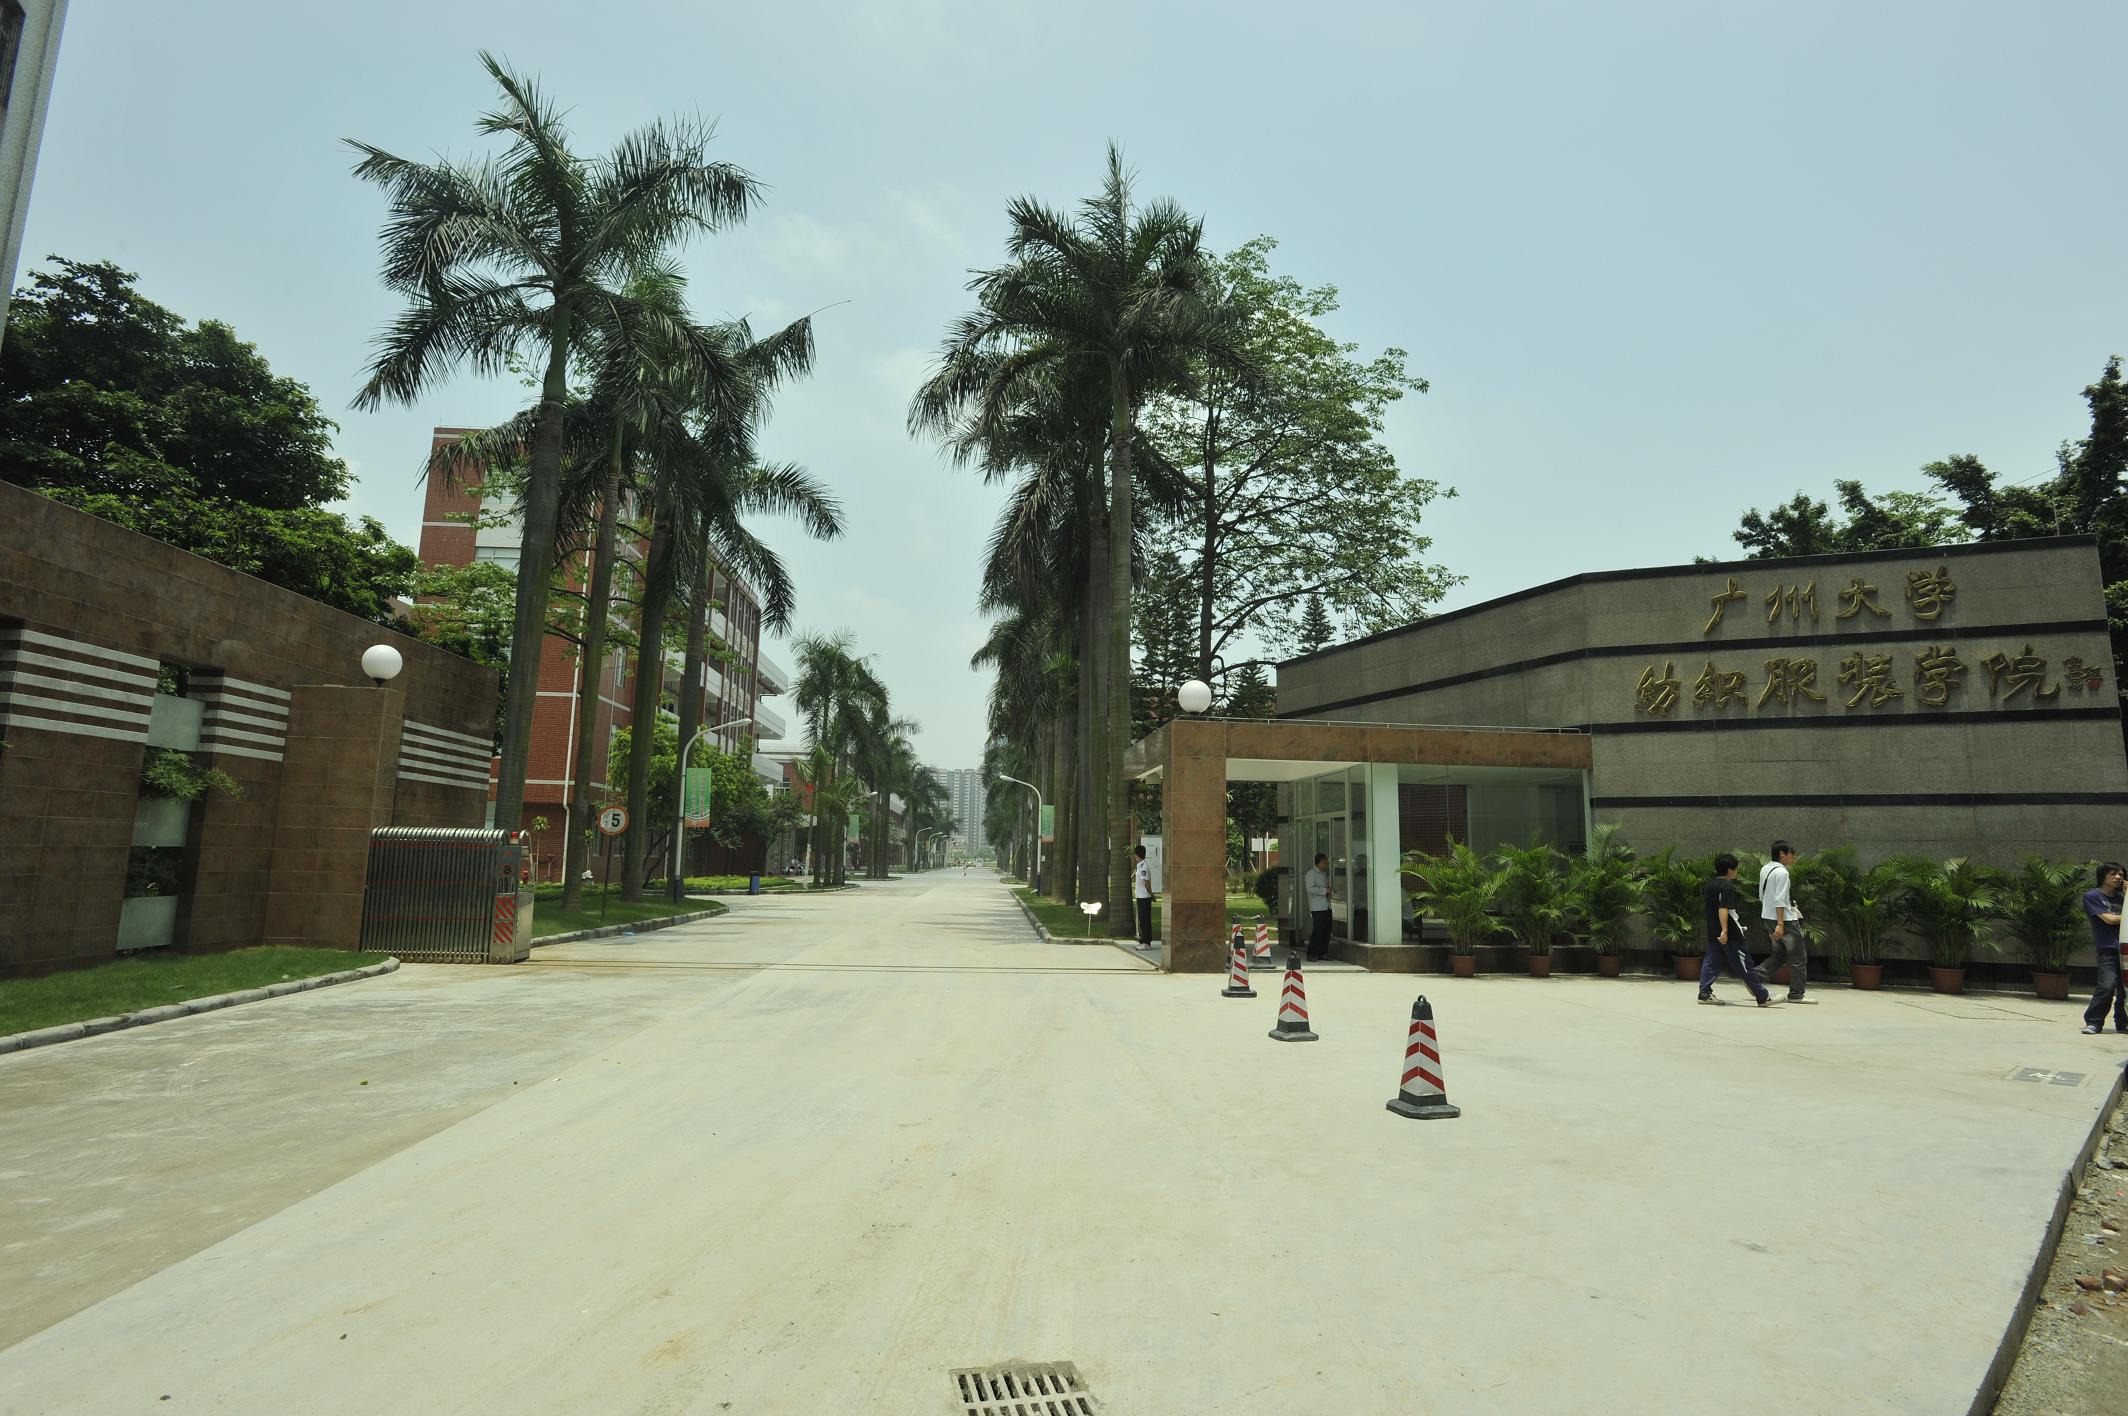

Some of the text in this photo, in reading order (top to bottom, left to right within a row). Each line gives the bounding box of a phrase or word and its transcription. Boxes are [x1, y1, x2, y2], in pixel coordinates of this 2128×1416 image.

[1703, 565, 1957, 635] 广州大学
[611, 813, 621, 828] 5
